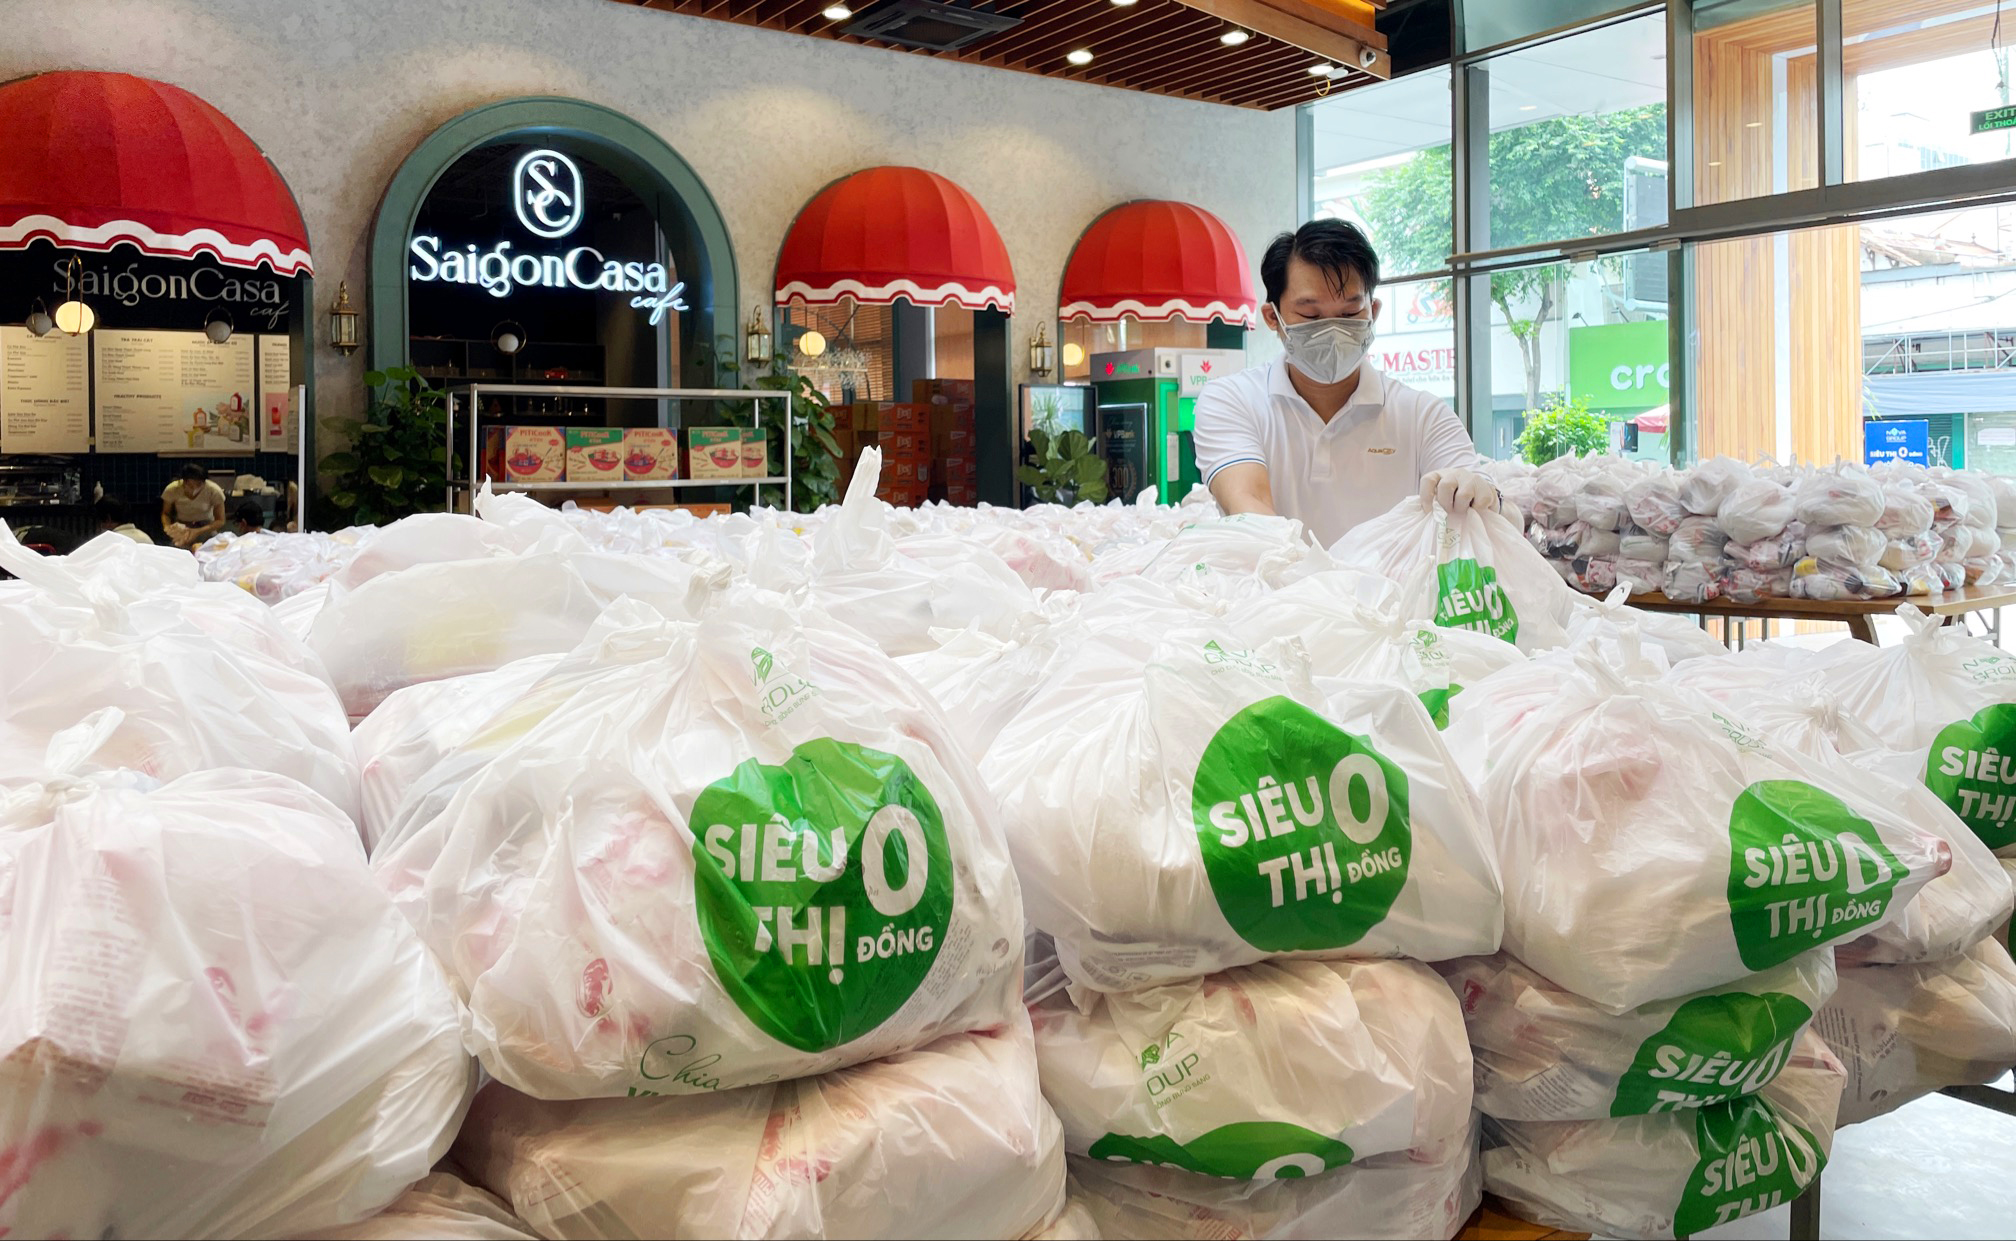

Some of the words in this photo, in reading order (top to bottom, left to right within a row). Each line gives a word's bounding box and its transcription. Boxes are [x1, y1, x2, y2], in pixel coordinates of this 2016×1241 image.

[1985, 108, 2016, 120] EXIT
[53, 259, 280, 306] SaigonCasa
[410, 236, 667, 297] SaigonCasa
[250, 302, 289, 330] caf
[1383, 348, 1456, 373] MASTE
[1440, 588, 1485, 621] IÊU
[1209, 775, 1324, 848] SIÊU
[1329, 753, 1389, 845] 0
[705, 813, 847, 883] SIÊU
[860, 804, 928, 917] 0
[1258, 841, 1343, 908] THỊ
[1347, 847, 1402, 884] ĐỒNG
[1744, 833, 1839, 889] SIÊU
[1765, 893, 1829, 939] THỊ
[1831, 898, 1881, 926] ĐỒNG
[754, 906, 847, 985] THỊ
[857, 922, 933, 963] ĐỒNG
[1146, 1052, 1199, 1096] OUP
[1648, 1045, 1753, 1088] SIÊU
[1701, 1131, 1779, 1196] SIÊU
